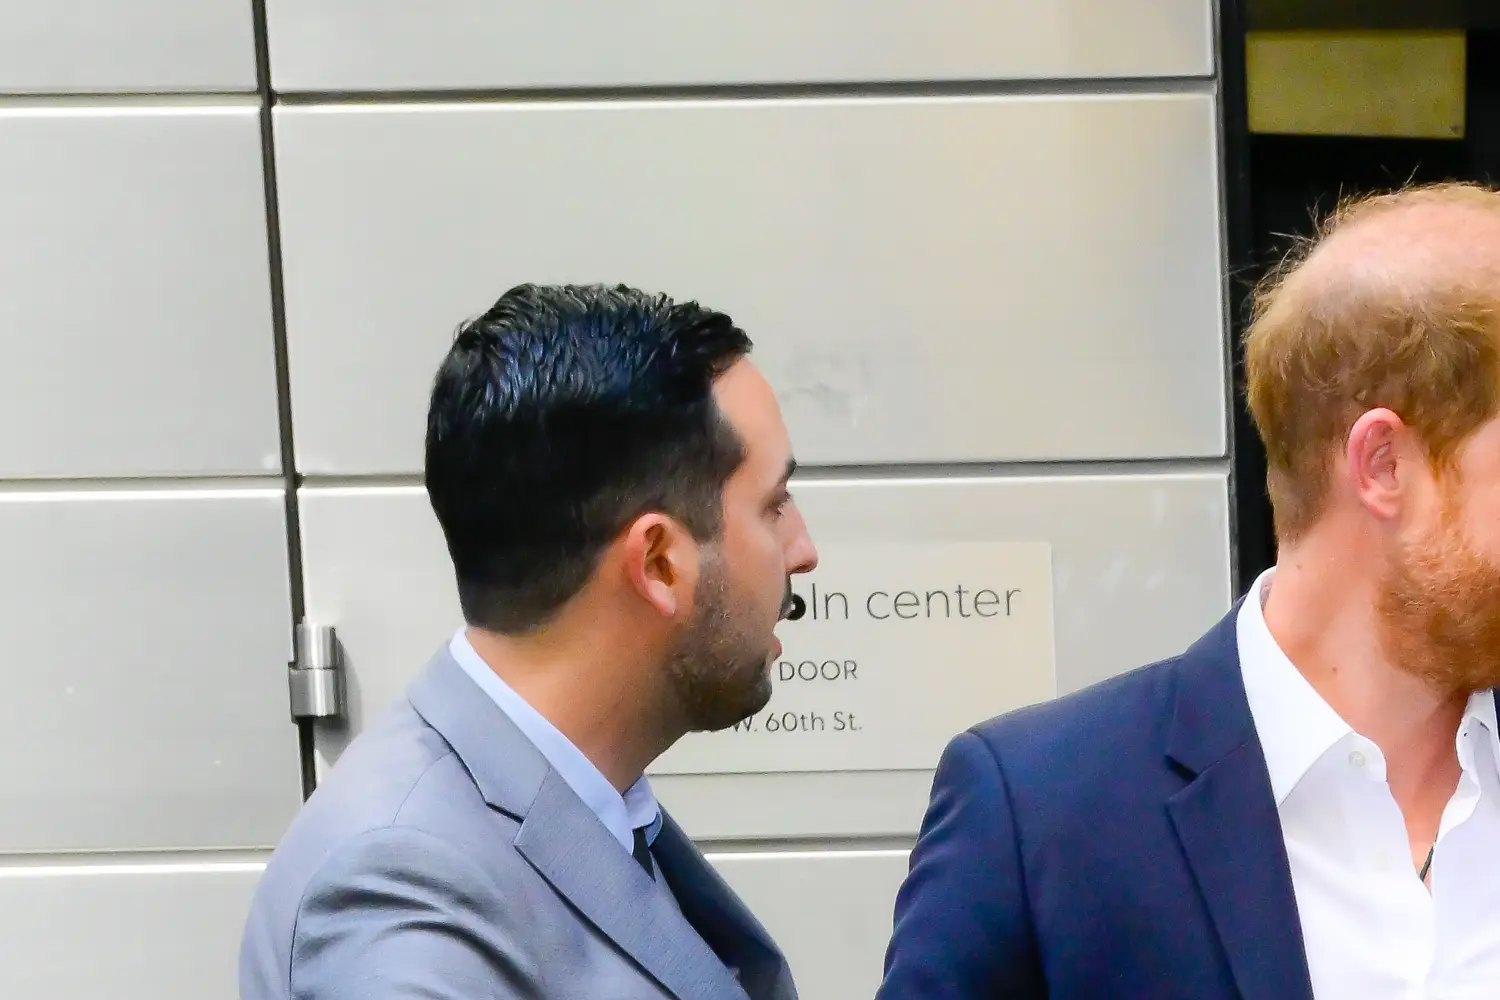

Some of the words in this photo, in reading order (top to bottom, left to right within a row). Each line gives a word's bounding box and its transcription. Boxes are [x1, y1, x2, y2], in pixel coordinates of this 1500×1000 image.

[866, 583, 1022, 620] center
[779, 660, 858, 681] DOOR
[765, 711, 825, 732] 60th
[833, 711, 863, 731] St.
